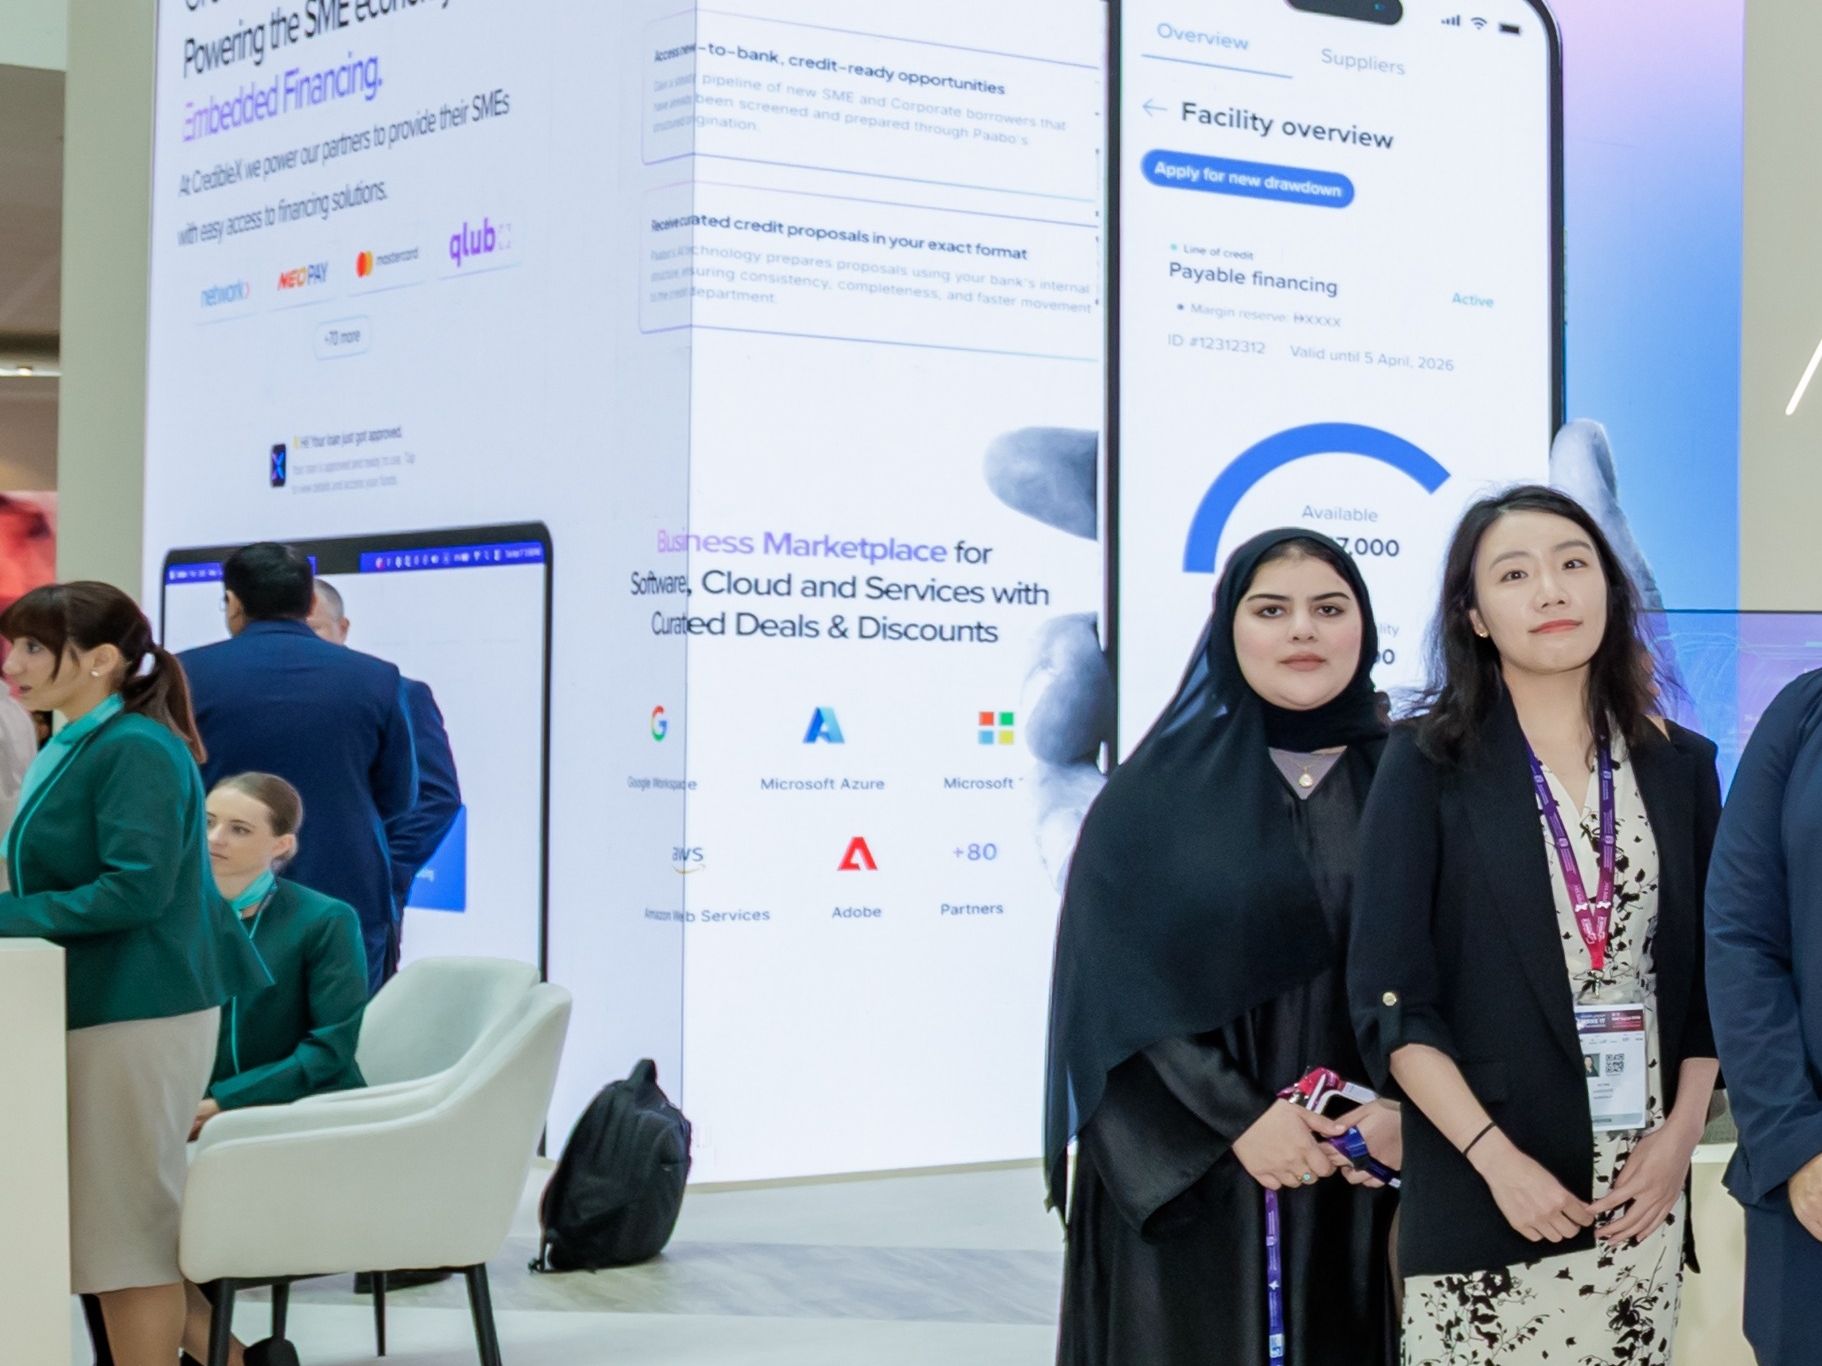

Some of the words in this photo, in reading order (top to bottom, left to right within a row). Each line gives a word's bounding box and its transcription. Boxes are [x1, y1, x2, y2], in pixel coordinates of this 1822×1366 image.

[184, 20, 265, 77] Powering
[269, 7, 299, 49] the
[1157, 22, 1249, 52] Overview
[1320, 47, 1406, 77] Suppliers
[183, 75, 278, 141] Embedded
[283, 51, 382, 112] Financing.
[1181, 101, 1274, 138] Facility
[1281, 118, 1394, 150] overview
[1154, 160, 1200, 183] Apply
[1203, 167, 1225, 184] for
[1229, 173, 1260, 188] new
[1264, 174, 1342, 199] drawdown
[449, 218, 496, 267] qlub
[733, 219, 784, 234] credit
[787, 225, 869, 243] proposals
[872, 232, 886, 244] in
[888, 236, 925, 249] your
[927, 241, 972, 254] exact
[975, 243, 1027, 260] format
[1184, 244, 1206, 255] Line
[1210, 248, 1220, 257] of
[1223, 249, 1254, 260] credit
[1169, 262, 1246, 286] Payable
[1252, 270, 1338, 298] financing
[1451, 292, 1495, 309] Active
[1167, 334, 1184, 348] ID
[1289, 345, 1325, 361] Valid
[1328, 348, 1360, 363] until
[1364, 351, 1374, 365] 5
[1377, 352, 1414, 371] April,
[1417, 356, 1455, 372] 2026
[1302, 505, 1378, 522] Available
[657, 529, 754, 555] Business
[763, 531, 947, 566] Marketplace
[955, 540, 992, 564] for
[631, 570, 692, 597] Software,
[702, 570, 792, 598] Cloud
[801, 574, 856, 599] and
[865, 575, 985, 604] Services
[992, 581, 1050, 606] with
[652, 611, 725, 636] Curated
[736, 612, 819, 638] Deals
[828, 615, 849, 639] &
[859, 615, 998, 643] Discounts
[761, 778, 835, 791] Microsoft
[840, 778, 885, 791] Azure
[944, 777, 1013, 791] Microsoft
[672, 846, 704, 862] aws
[953, 843, 997, 862] +80
[832, 905, 882, 919] Adobe
[941, 902, 1004, 916] Partners
